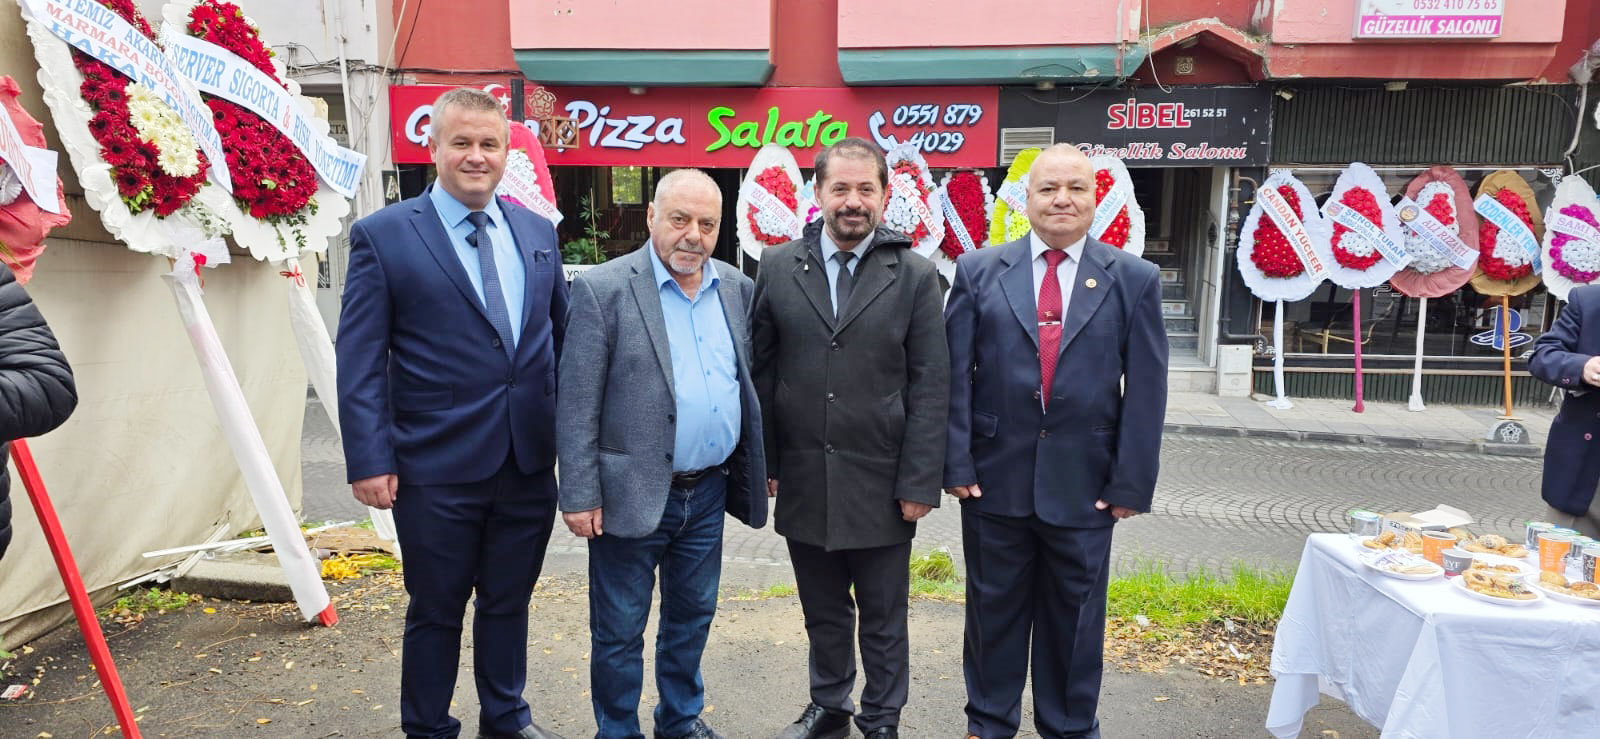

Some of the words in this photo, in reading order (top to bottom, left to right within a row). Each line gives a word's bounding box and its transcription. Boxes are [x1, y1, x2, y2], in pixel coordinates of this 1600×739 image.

[1413, 0, 1440, 10] 0532
[1467, 0, 1480, 10] 75
[47, 2, 140, 65] MARMARA
[1363, 15, 1434, 35] GÜZELLİK
[1436, 19, 1498, 35] SALONU
[51, 20, 157, 91] HAKAN
[173, 44, 226, 88] SERVER
[228, 65, 280, 120] SİGORTA
[282, 104, 291, 130] &
[559, 100, 686, 152] Pizza
[705, 106, 848, 152] Salata
[892, 103, 940, 126] 0551
[942, 103, 983, 126] 879
[1107, 98, 1191, 129] SİBEL
[1184, 108, 1200, 118] 261
[1202, 108, 1214, 118] 52
[1215, 108, 1227, 118] 51
[909, 130, 965, 153] 4029
[1075, 142, 1163, 161] Güzellik
[1167, 142, 1248, 160] Salonu
[913, 200, 943, 240] SOYUER
[1263, 188, 1297, 228] CANDAN
[1377, 231, 1406, 258] TURAN
